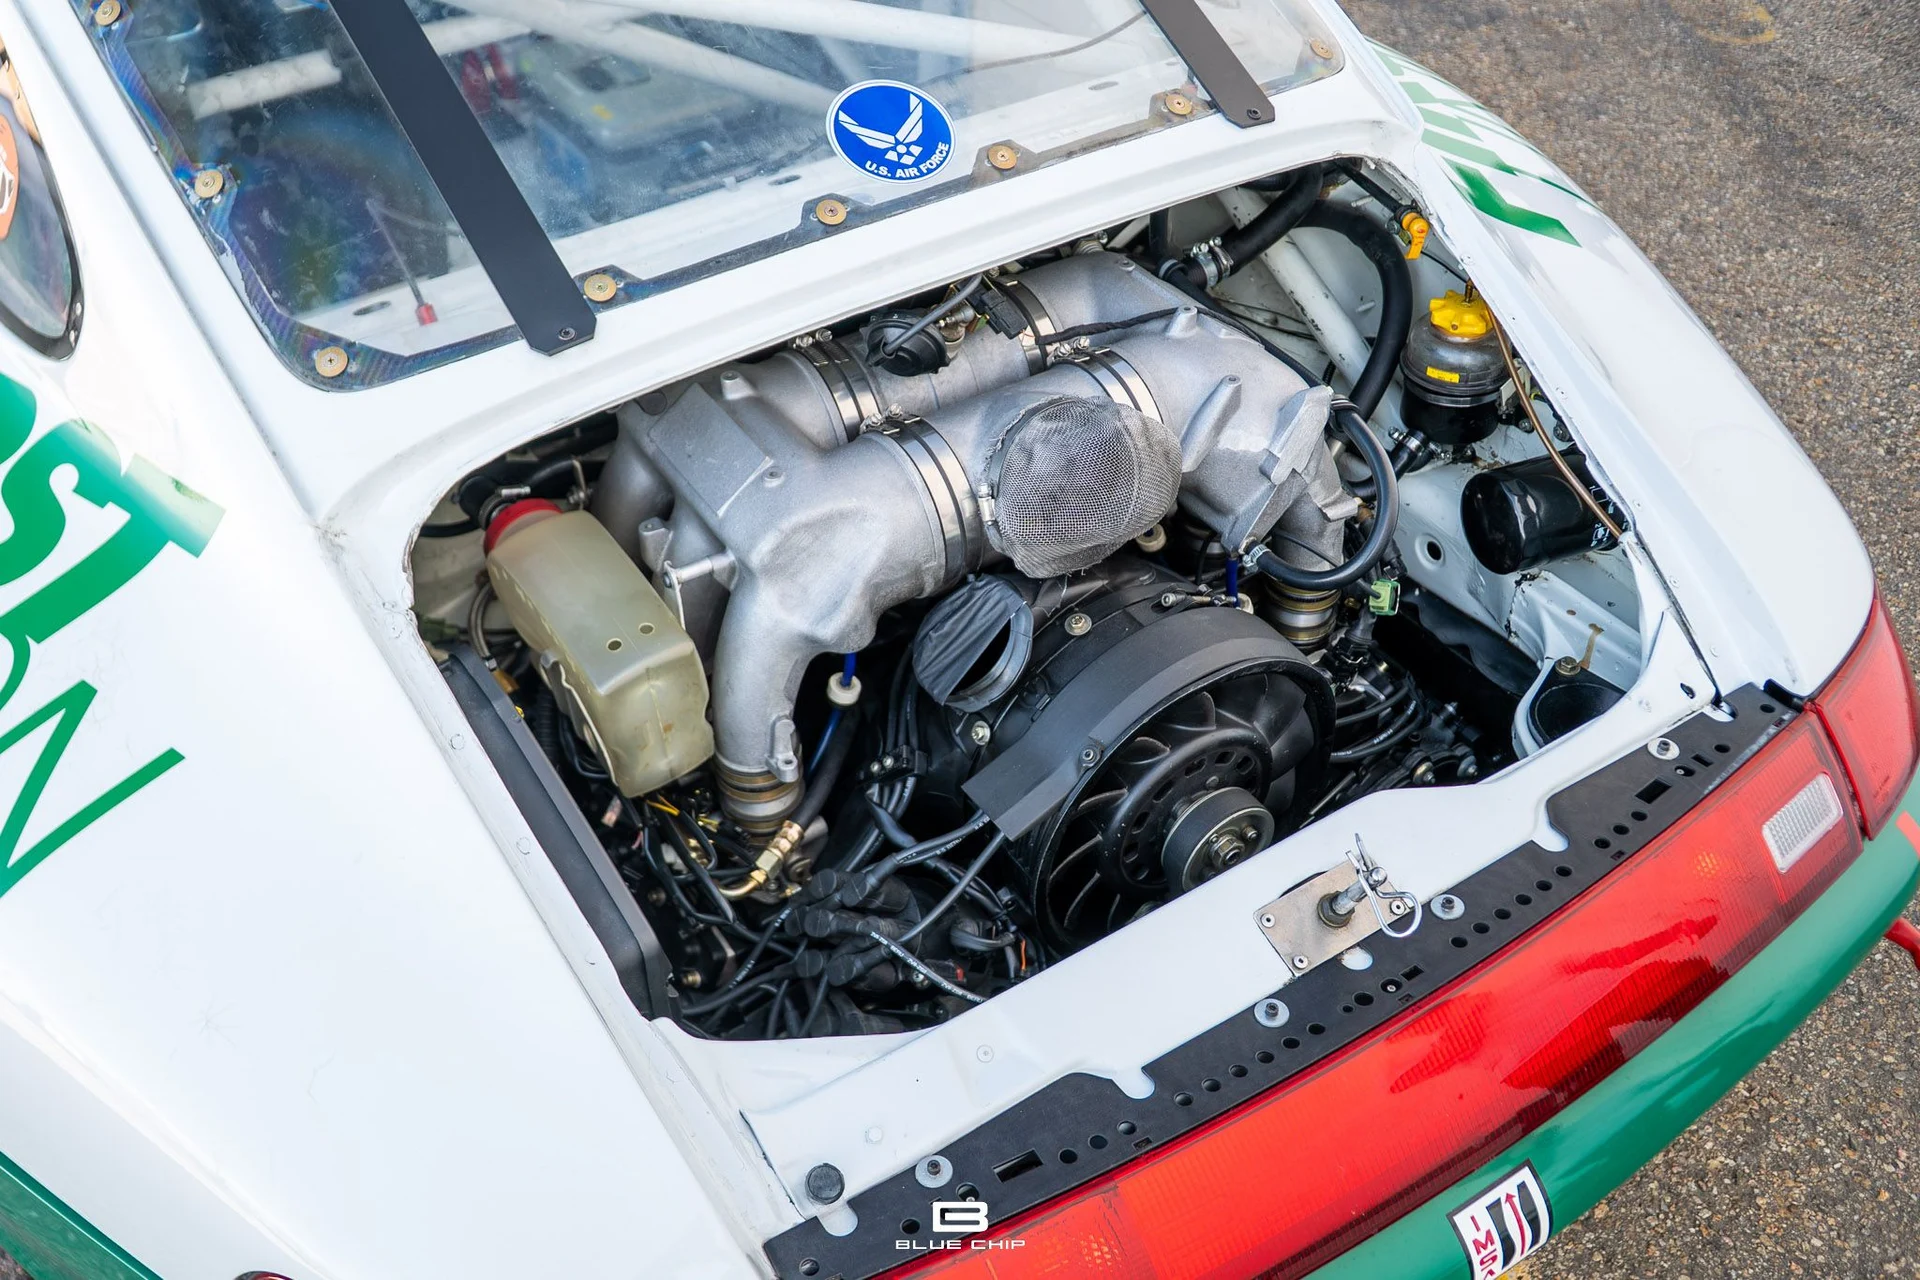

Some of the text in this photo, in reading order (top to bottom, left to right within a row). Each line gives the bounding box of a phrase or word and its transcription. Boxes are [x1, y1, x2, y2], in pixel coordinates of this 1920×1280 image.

[865, 142, 949, 178] U.S. AIR FORCE
